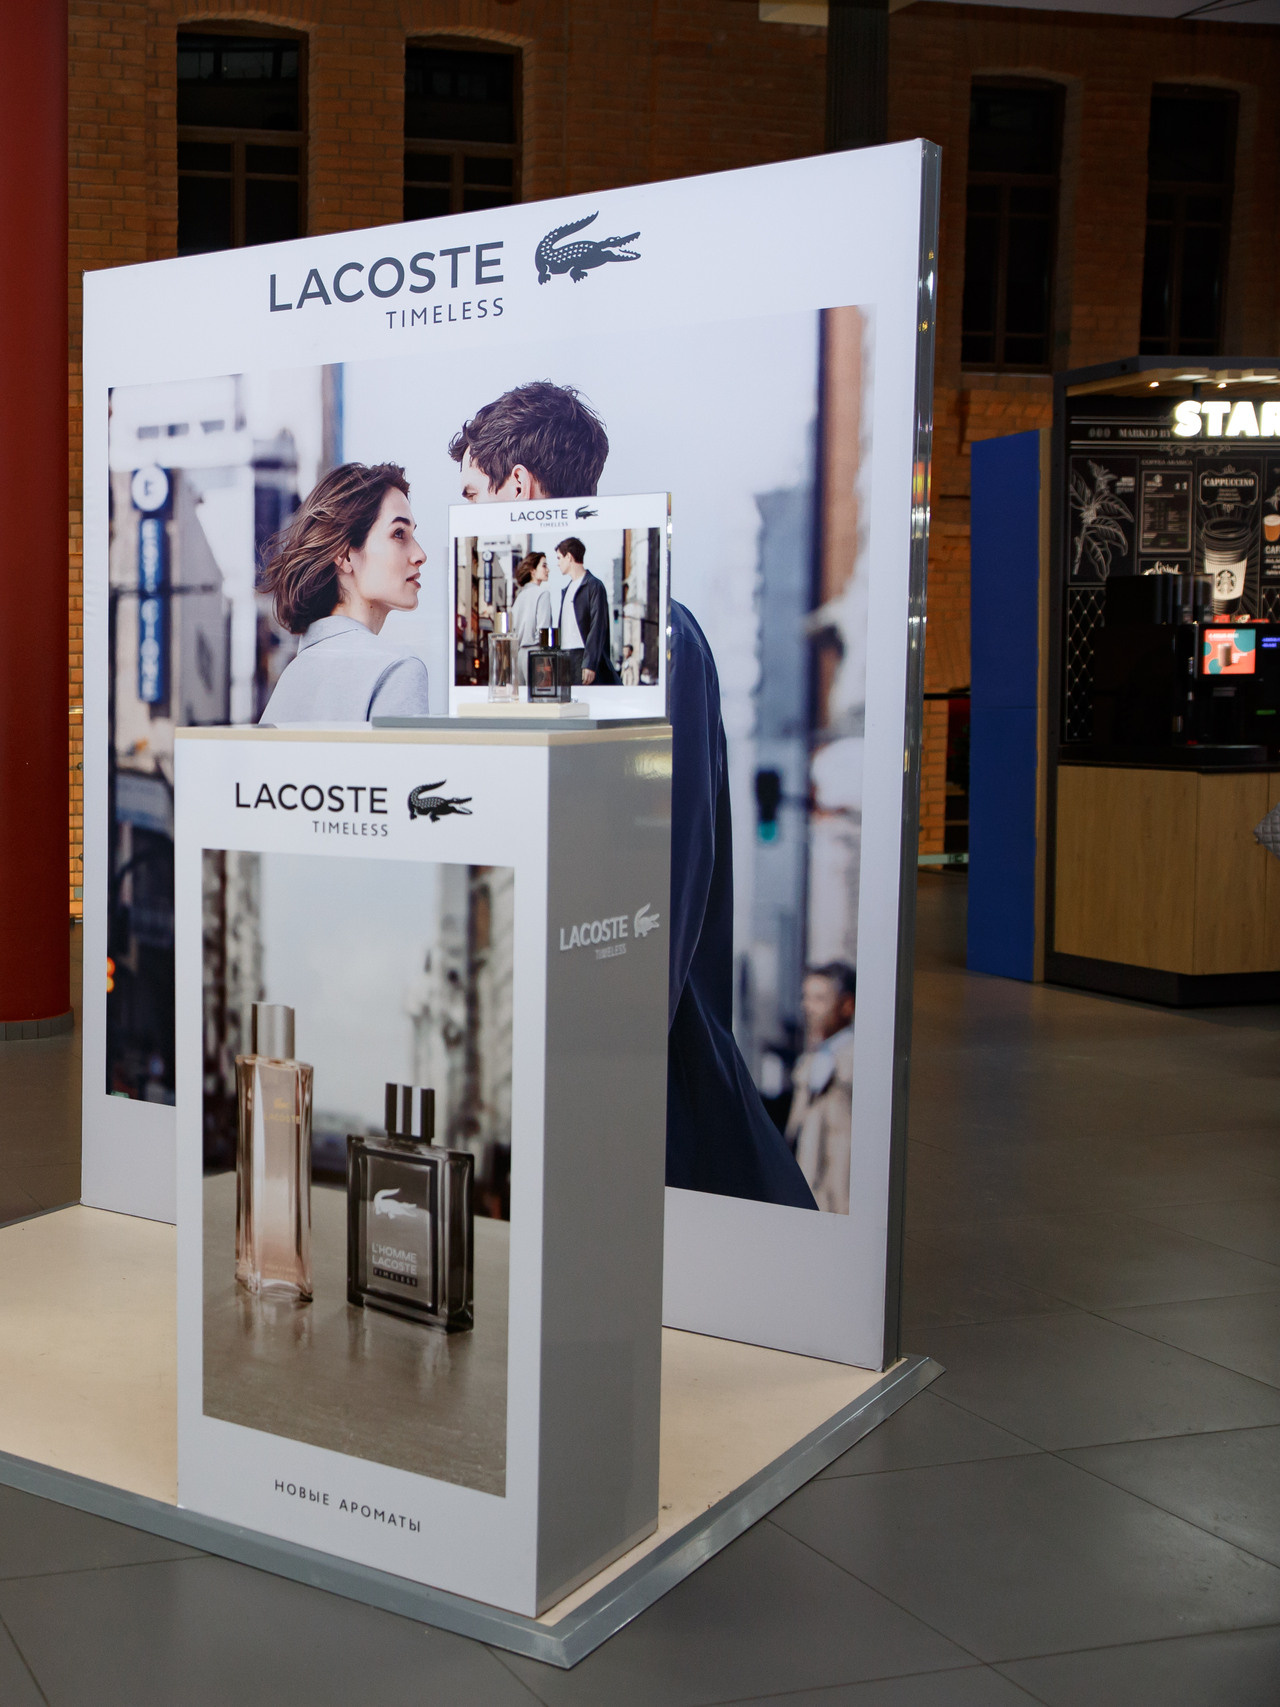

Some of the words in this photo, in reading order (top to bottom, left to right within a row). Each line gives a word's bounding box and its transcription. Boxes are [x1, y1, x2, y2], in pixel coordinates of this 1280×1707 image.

[269, 241, 504, 312] LACOSTE
[386, 298, 504, 329] TIMELESS
[1203, 478, 1255, 487] CAPPUCCINO
[510, 509, 568, 522] LACOSTE
[236, 782, 388, 814] LACOSTE
[312, 820, 388, 837] TIMELESS
[560, 915, 628, 951] LACOSTE
[595, 943, 627, 960] TIMELESS
[372, 1242, 417, 1264] L'HOMME
[372, 1255, 417, 1275] LACOSTE
[274, 1479, 330, 1506] НОВЫЕ
[339, 1499, 420, 1533] АРОМАТЫ
